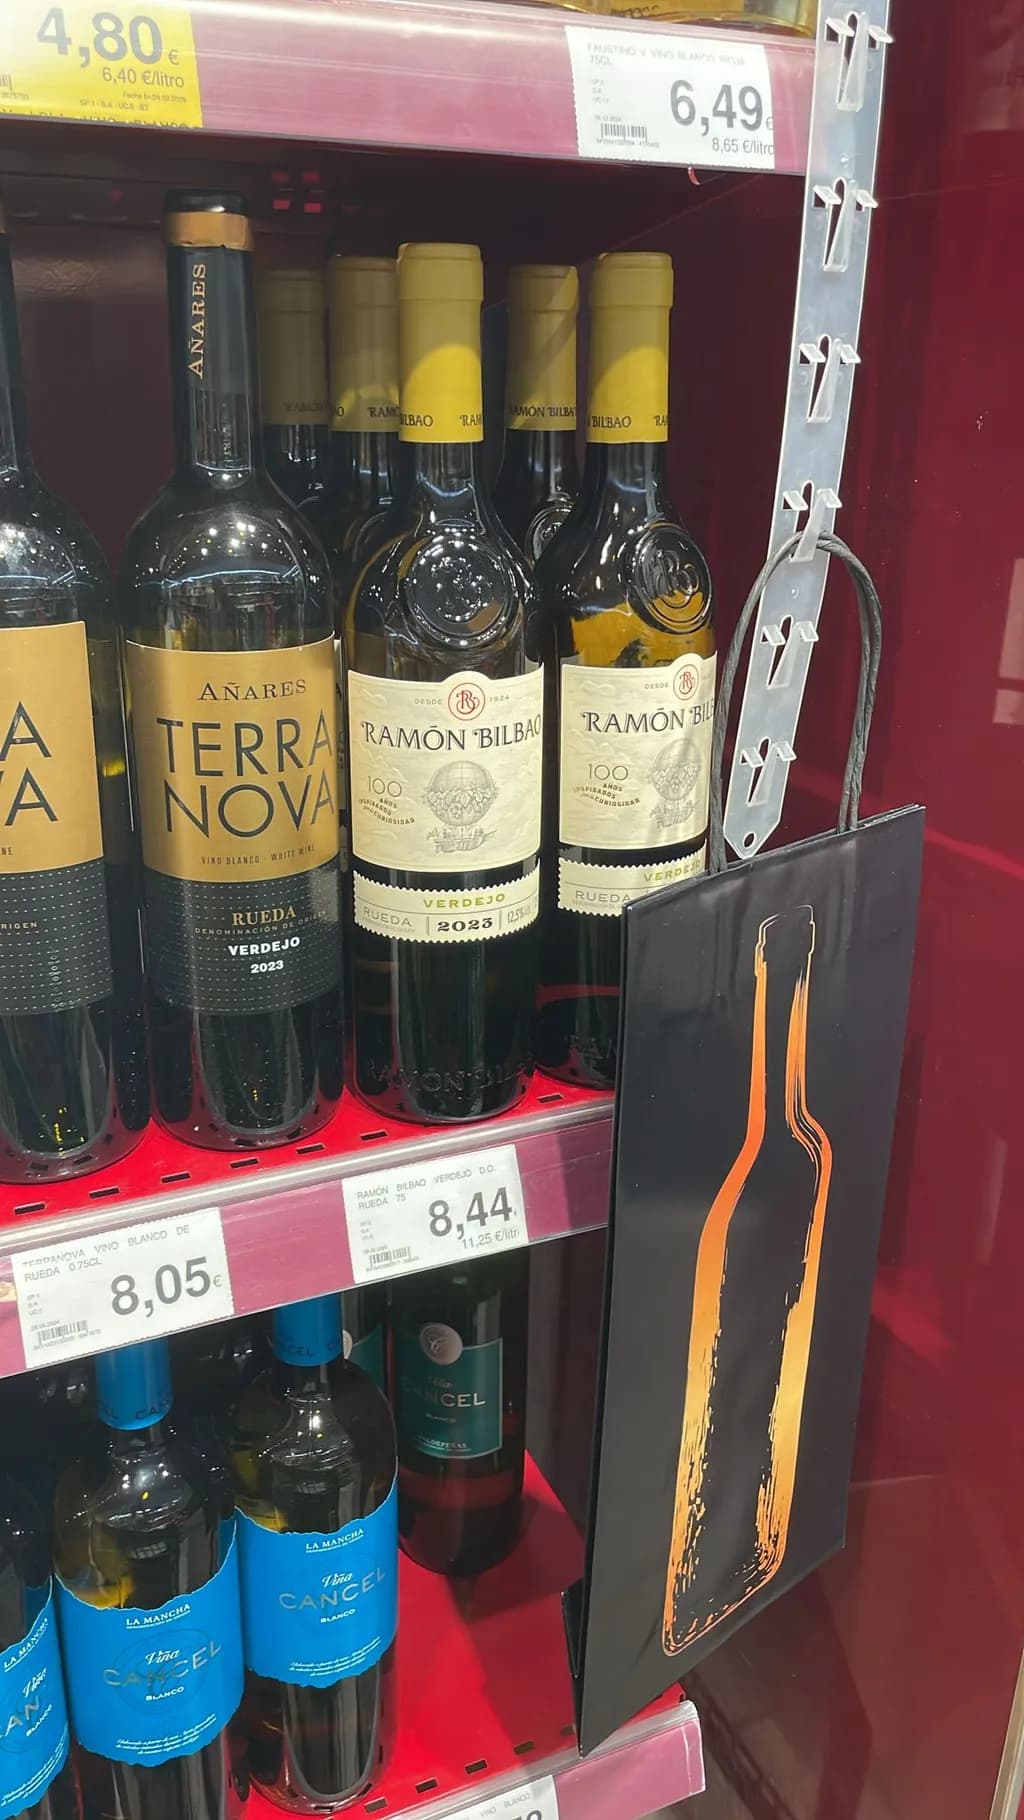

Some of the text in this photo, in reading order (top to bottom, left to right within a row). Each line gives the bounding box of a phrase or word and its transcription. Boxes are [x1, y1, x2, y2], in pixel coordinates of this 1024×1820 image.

[37, 7, 163, 68] 4,80
[102, 67, 185, 89] 6,40 €/litro
[670, 80, 763, 136] 6,49
[712, 138, 739, 154] 8,65
[188, 263, 207, 379] AÑARES
[592, 415, 632, 429] BILBAO
[196, 679, 307, 701] AÑARES
[156, 708, 334, 777] TERRA
[473, 714, 542, 749] BILBAO
[588, 763, 629, 781] 100
[367, 775, 403, 798] 100
[163, 768, 335, 839] NOVA
[201, 856, 222, 865] VINO
[226, 855, 260, 865] BLANCO
[271, 849, 296, 861] WHITE
[643, 858, 702, 883] VERDEJO
[423, 892, 506, 909] VERDEJO
[575, 890, 632, 903] RUEDA
[231, 904, 297, 926] RUEDA
[362, 905, 413, 928] RUEDA
[437, 917, 494, 933] 2023
[228, 936, 302, 957] VERDEJO
[250, 960, 285, 974] 2023
[356, 1186, 389, 1200] RAMÓN
[396, 1178, 427, 1193] BILBAO
[434, 1169, 472, 1185] VERDEJO
[357, 1193, 407, 1211] RUEDA 75
[428, 1186, 513, 1241] 8,44
[94, 1241, 119, 1255] VINO
[127, 1230, 168, 1247] BLANCO
[176, 1224, 190, 1236] DE
[462, 1228, 520, 1250] 11,25 €/litr
[24, 1267, 61, 1282] RUEDA
[110, 1256, 211, 1318] 8,05
[305, 1542, 319, 1551] LA
[321, 1528, 365, 1548] MANCHA
[278, 1567, 386, 1611] CANCEL
[321, 1572, 353, 1589] Viña
[126, 1617, 136, 1627] LA
[142, 1603, 191, 1623] MANCHA
[320, 1608, 356, 1624] BLANCO
[3, 1656, 17, 1669] LA
[103, 1638, 222, 1687] CANCEL
[145, 1649, 181, 1666] Viña
[145, 1686, 185, 1702] BLANCO
[503, 1792, 531, 1809] BLANCO
